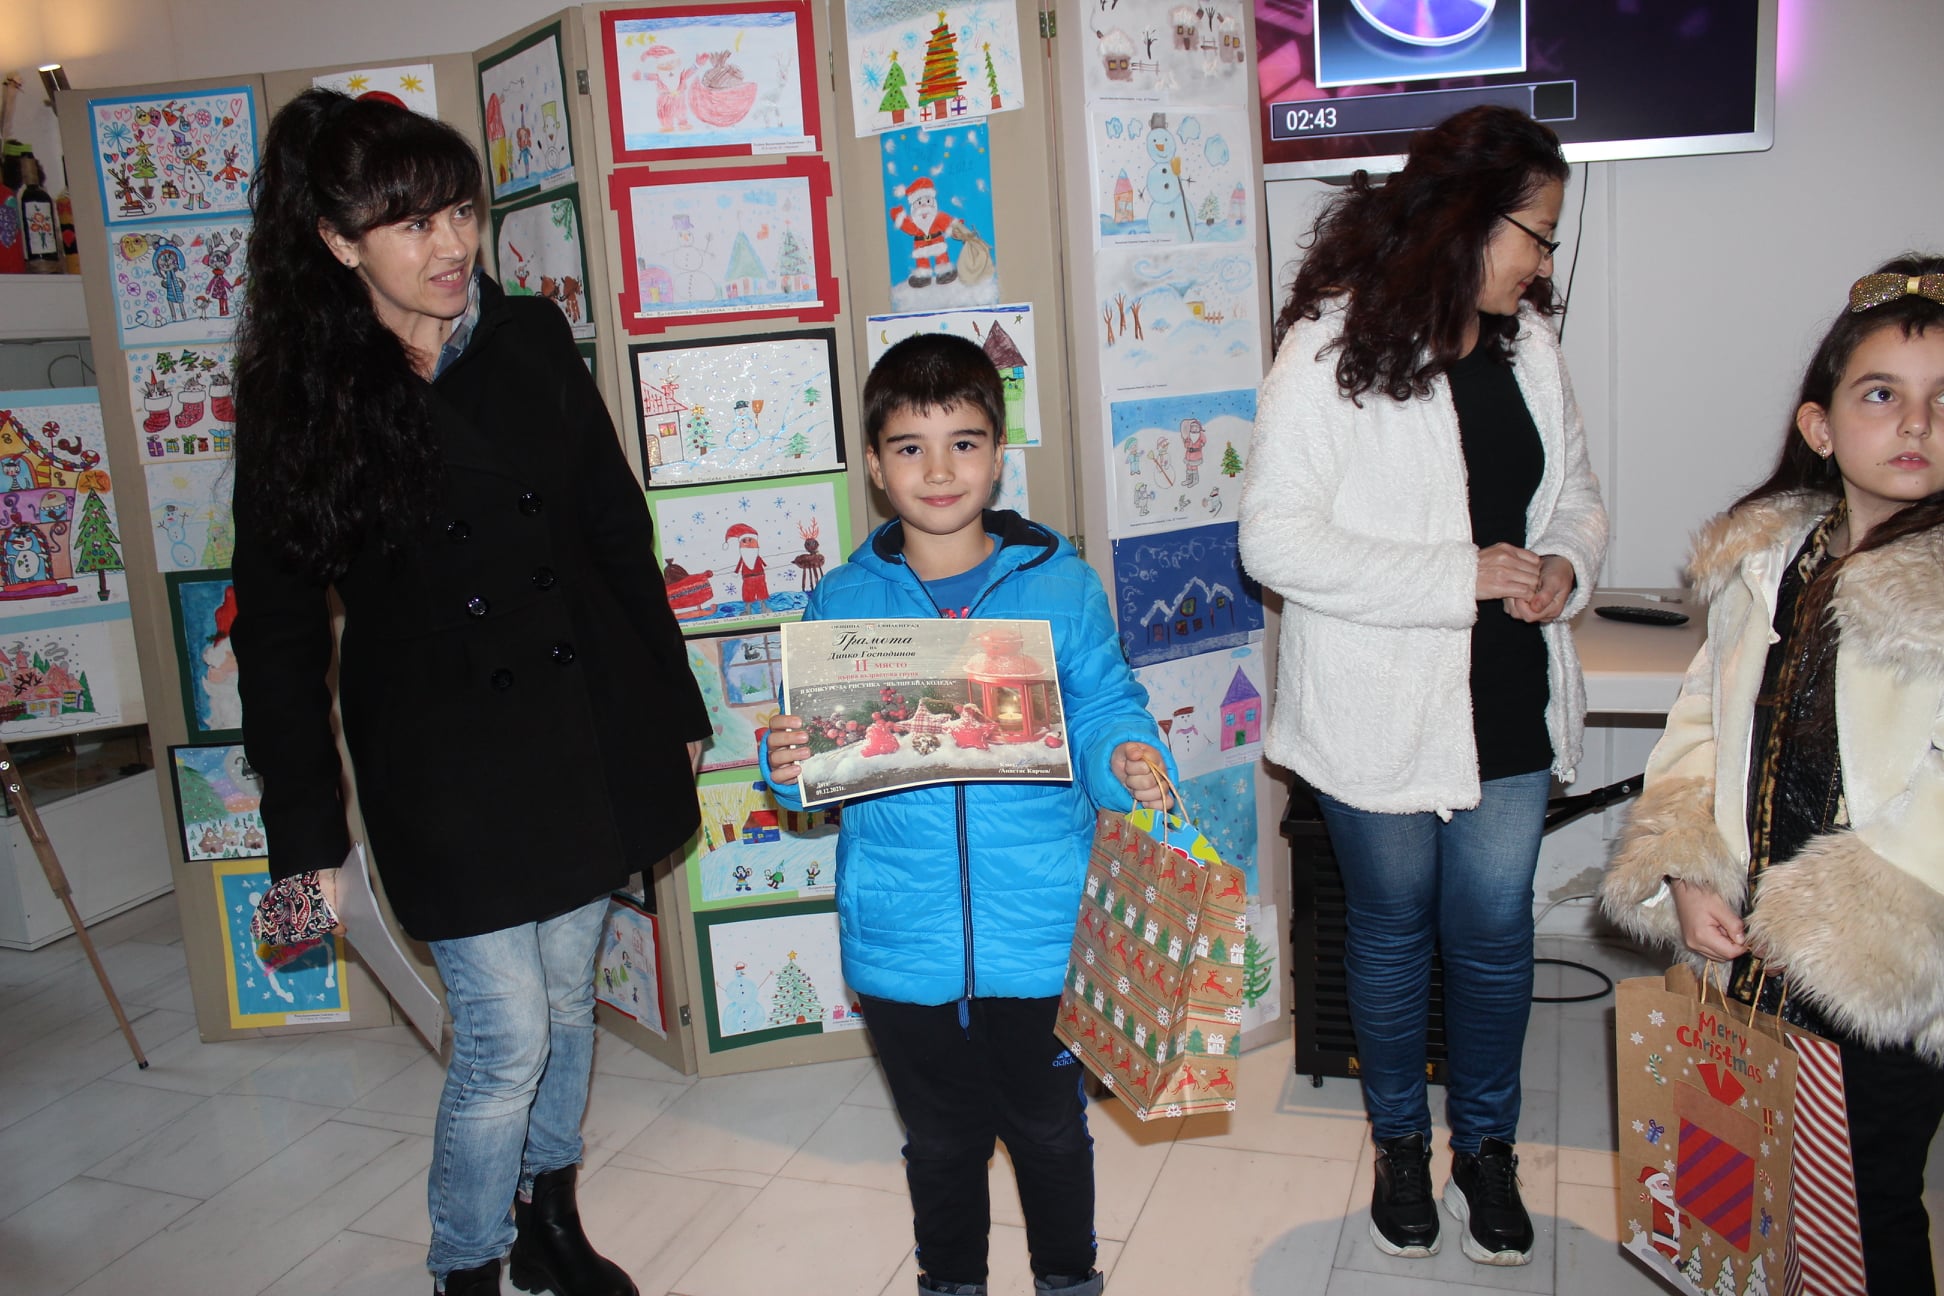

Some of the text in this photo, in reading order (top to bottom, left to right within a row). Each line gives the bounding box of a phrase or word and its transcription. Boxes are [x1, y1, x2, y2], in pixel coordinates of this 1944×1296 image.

[1285, 108, 1338, 132] 02:43
[831, 631, 913, 651] Грамота
[860, 650, 916, 658] Господинов
[1698, 1011, 1747, 1056] Merry
[1052, 1056, 1077, 1067] adida
[1676, 1025, 1763, 1084] Christmas
